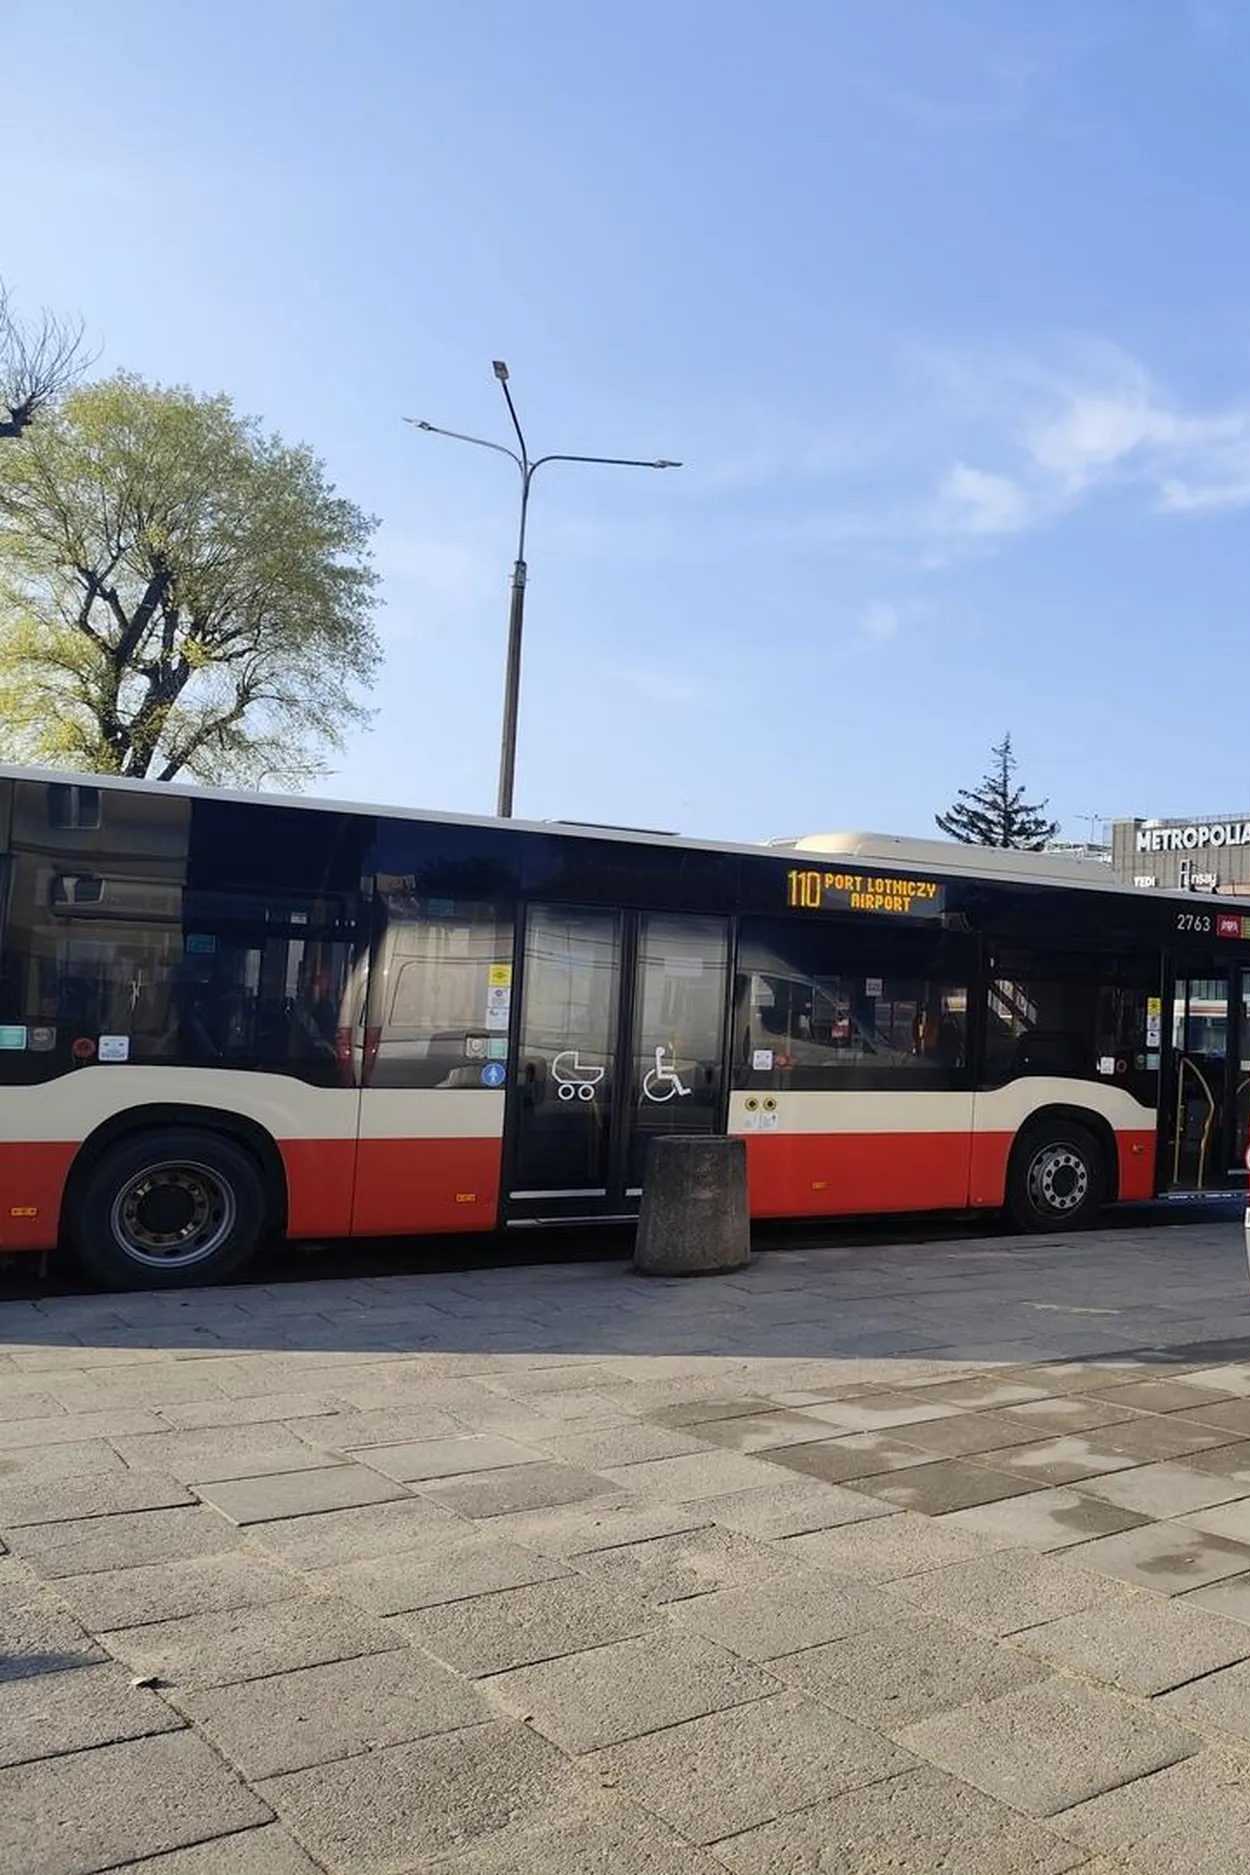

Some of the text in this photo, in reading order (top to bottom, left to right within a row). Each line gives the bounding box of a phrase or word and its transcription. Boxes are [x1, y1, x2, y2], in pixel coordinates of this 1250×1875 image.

[788, 870, 821, 907] 110
[825, 873, 936, 898] PORT LOTNICZY
[851, 892, 911, 912] AIRPORT
[1177, 914, 1211, 932] 2763
